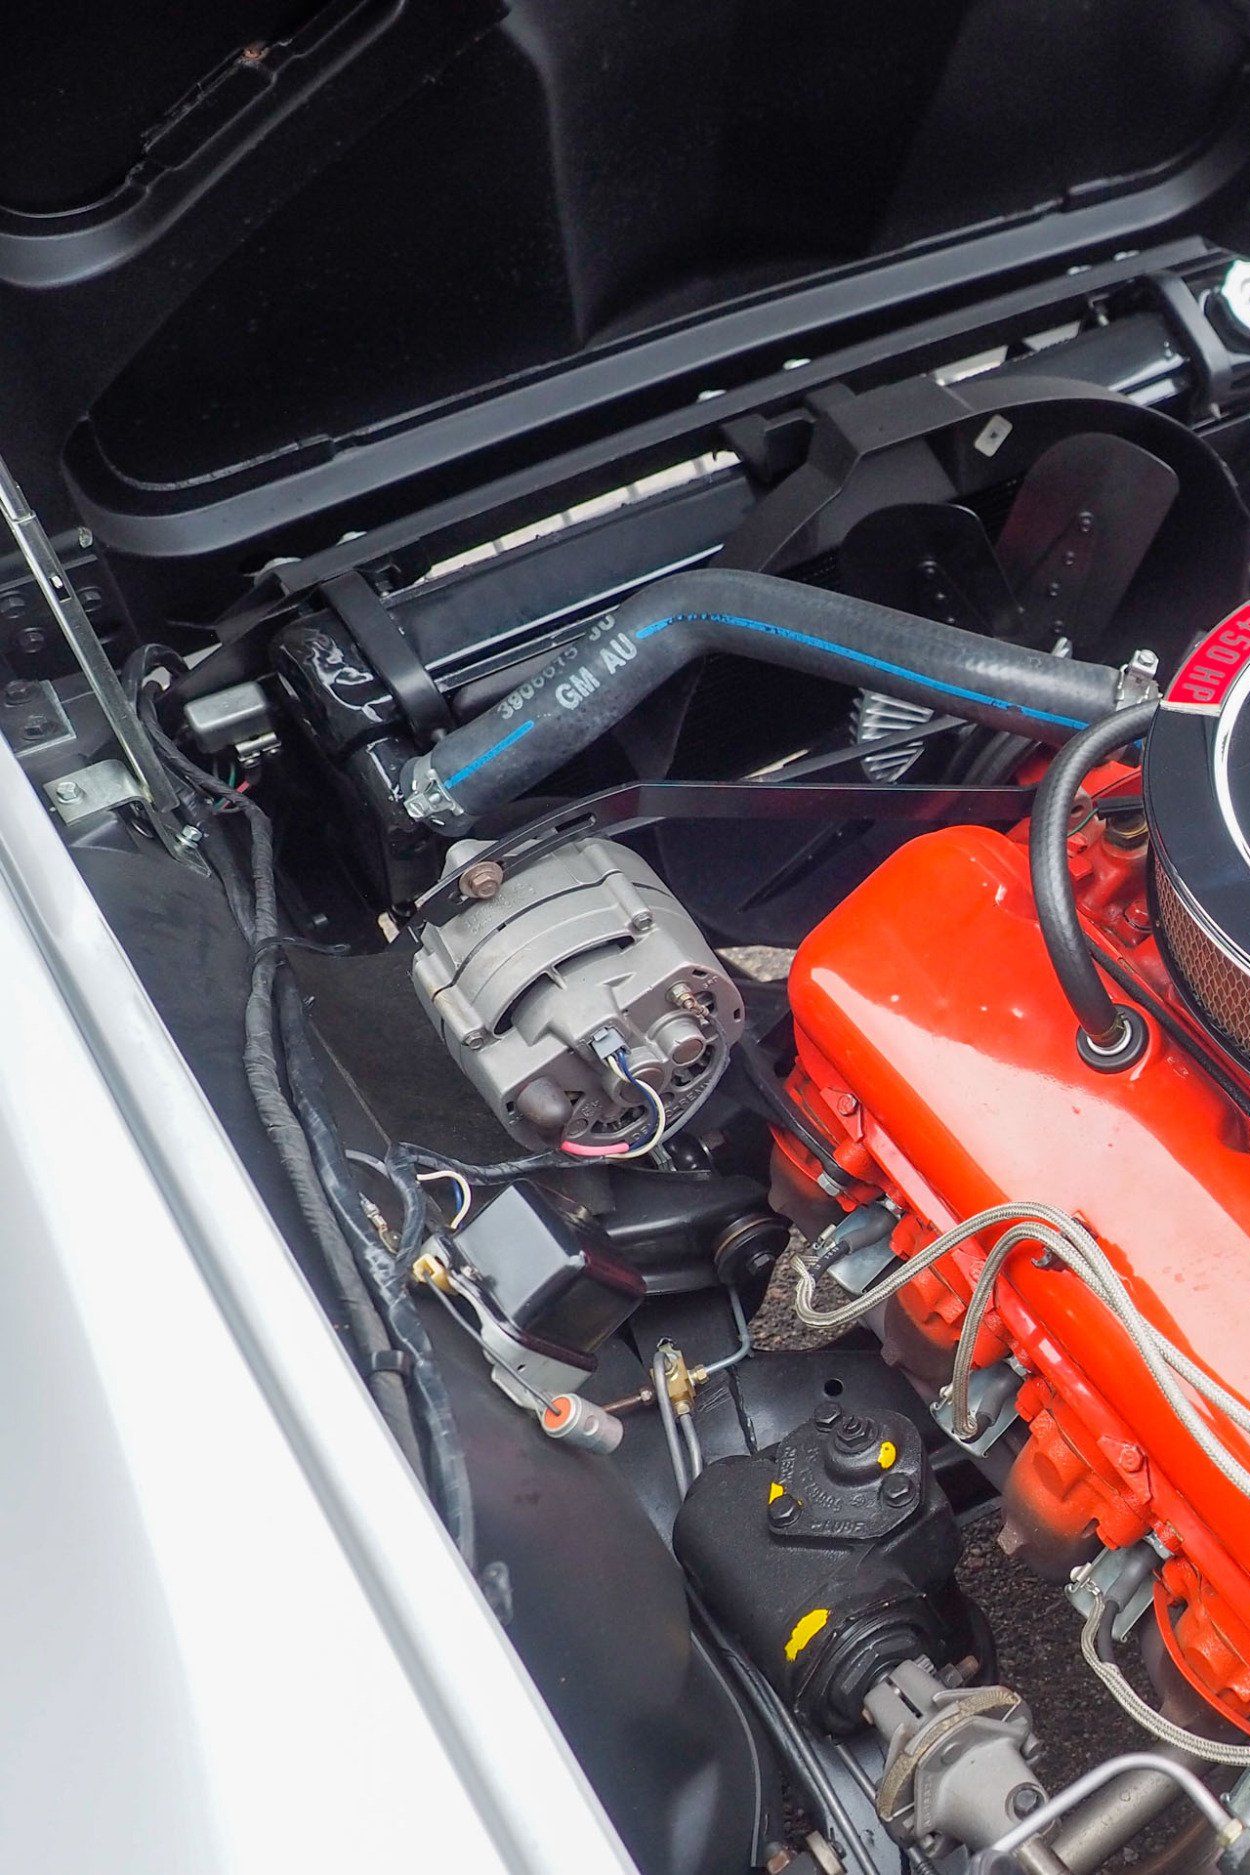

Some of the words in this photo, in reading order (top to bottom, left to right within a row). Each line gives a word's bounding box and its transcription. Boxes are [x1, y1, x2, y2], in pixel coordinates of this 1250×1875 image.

[555, 666, 600, 710] GM
[600, 632, 638, 675] AU
[1182, 665, 1226, 701] HP
